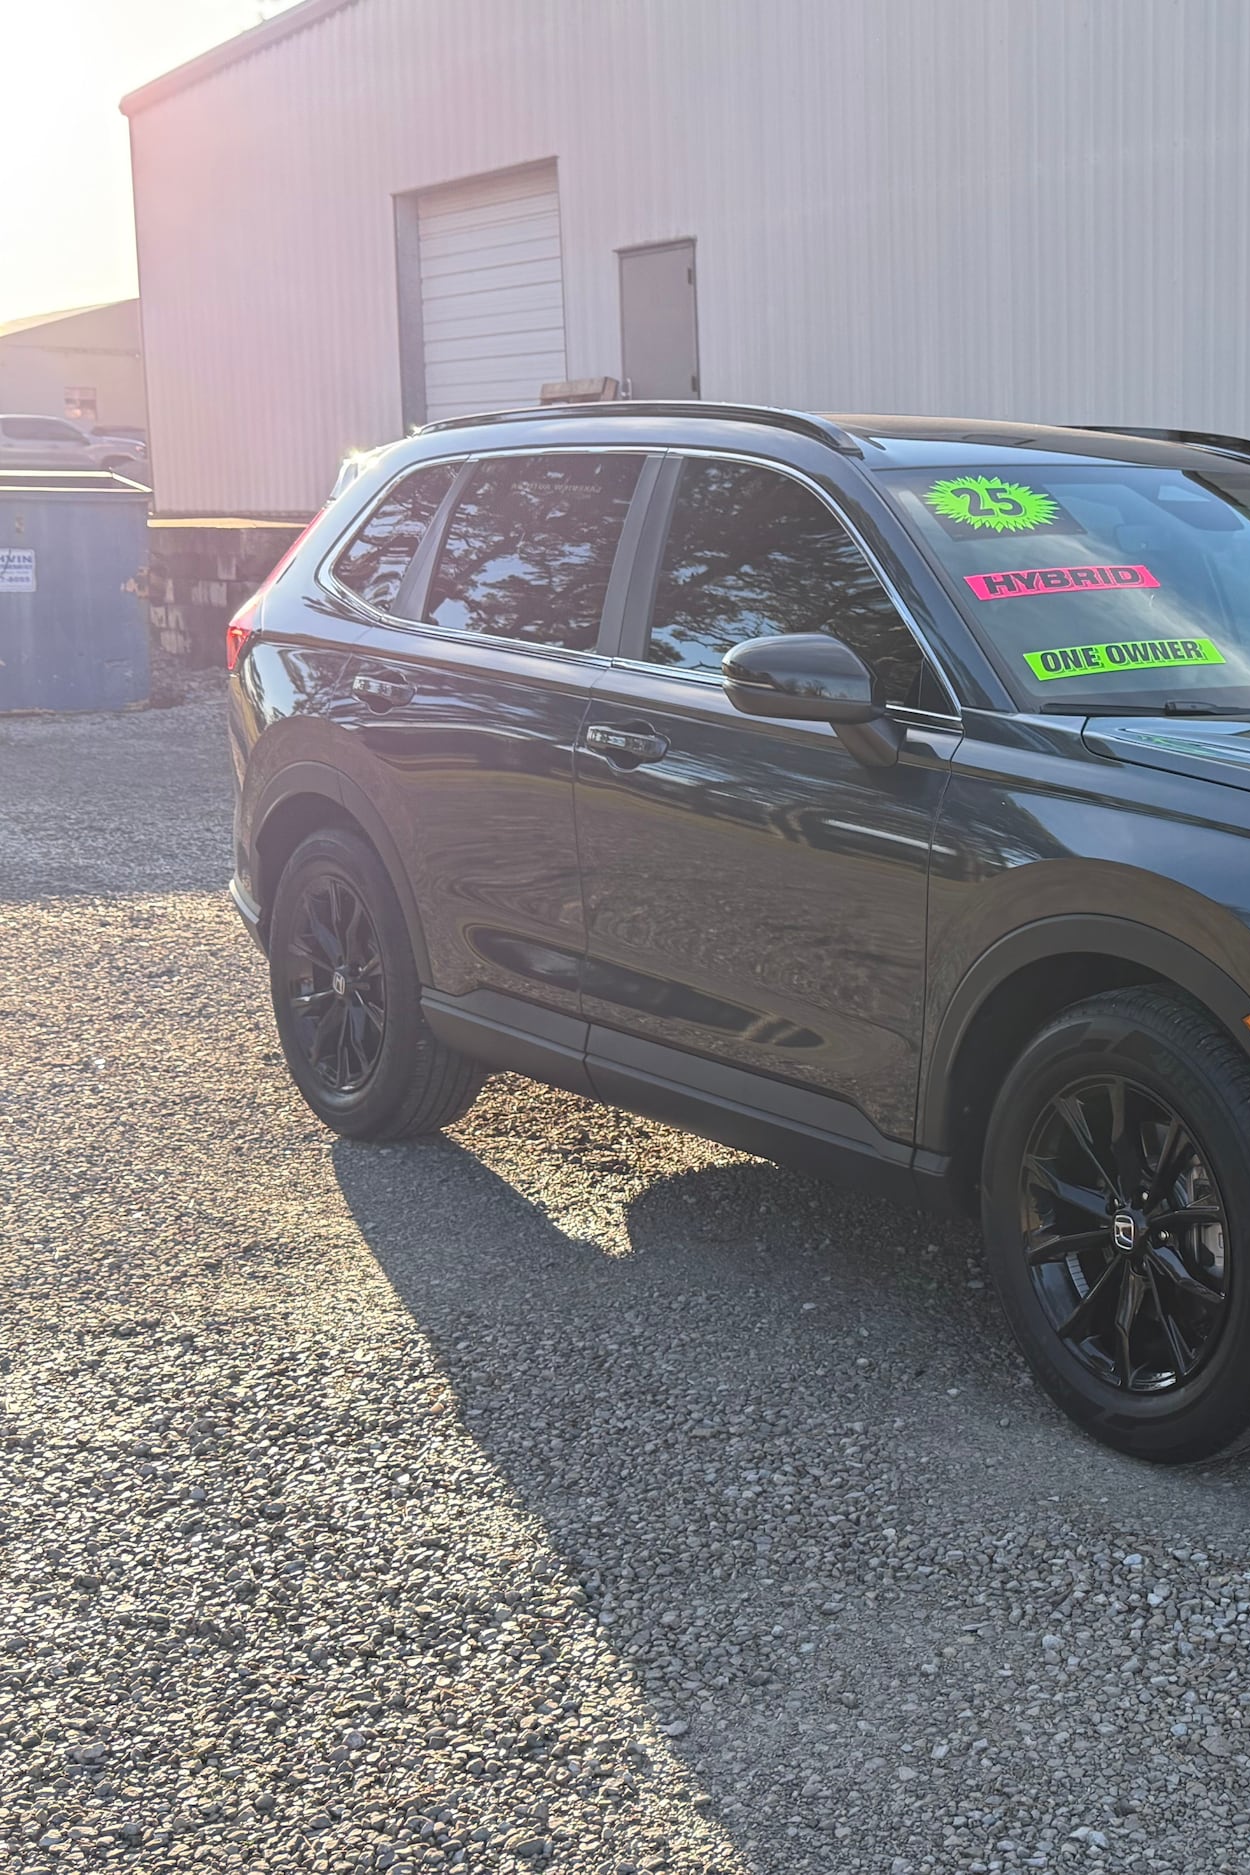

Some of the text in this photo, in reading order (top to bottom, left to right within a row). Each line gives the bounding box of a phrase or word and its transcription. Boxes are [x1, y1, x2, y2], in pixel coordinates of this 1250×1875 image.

[950, 487, 1024, 517] 25
[982, 567, 1145, 595] HYBRID
[1040, 640, 1206, 673] ONE OWNER
